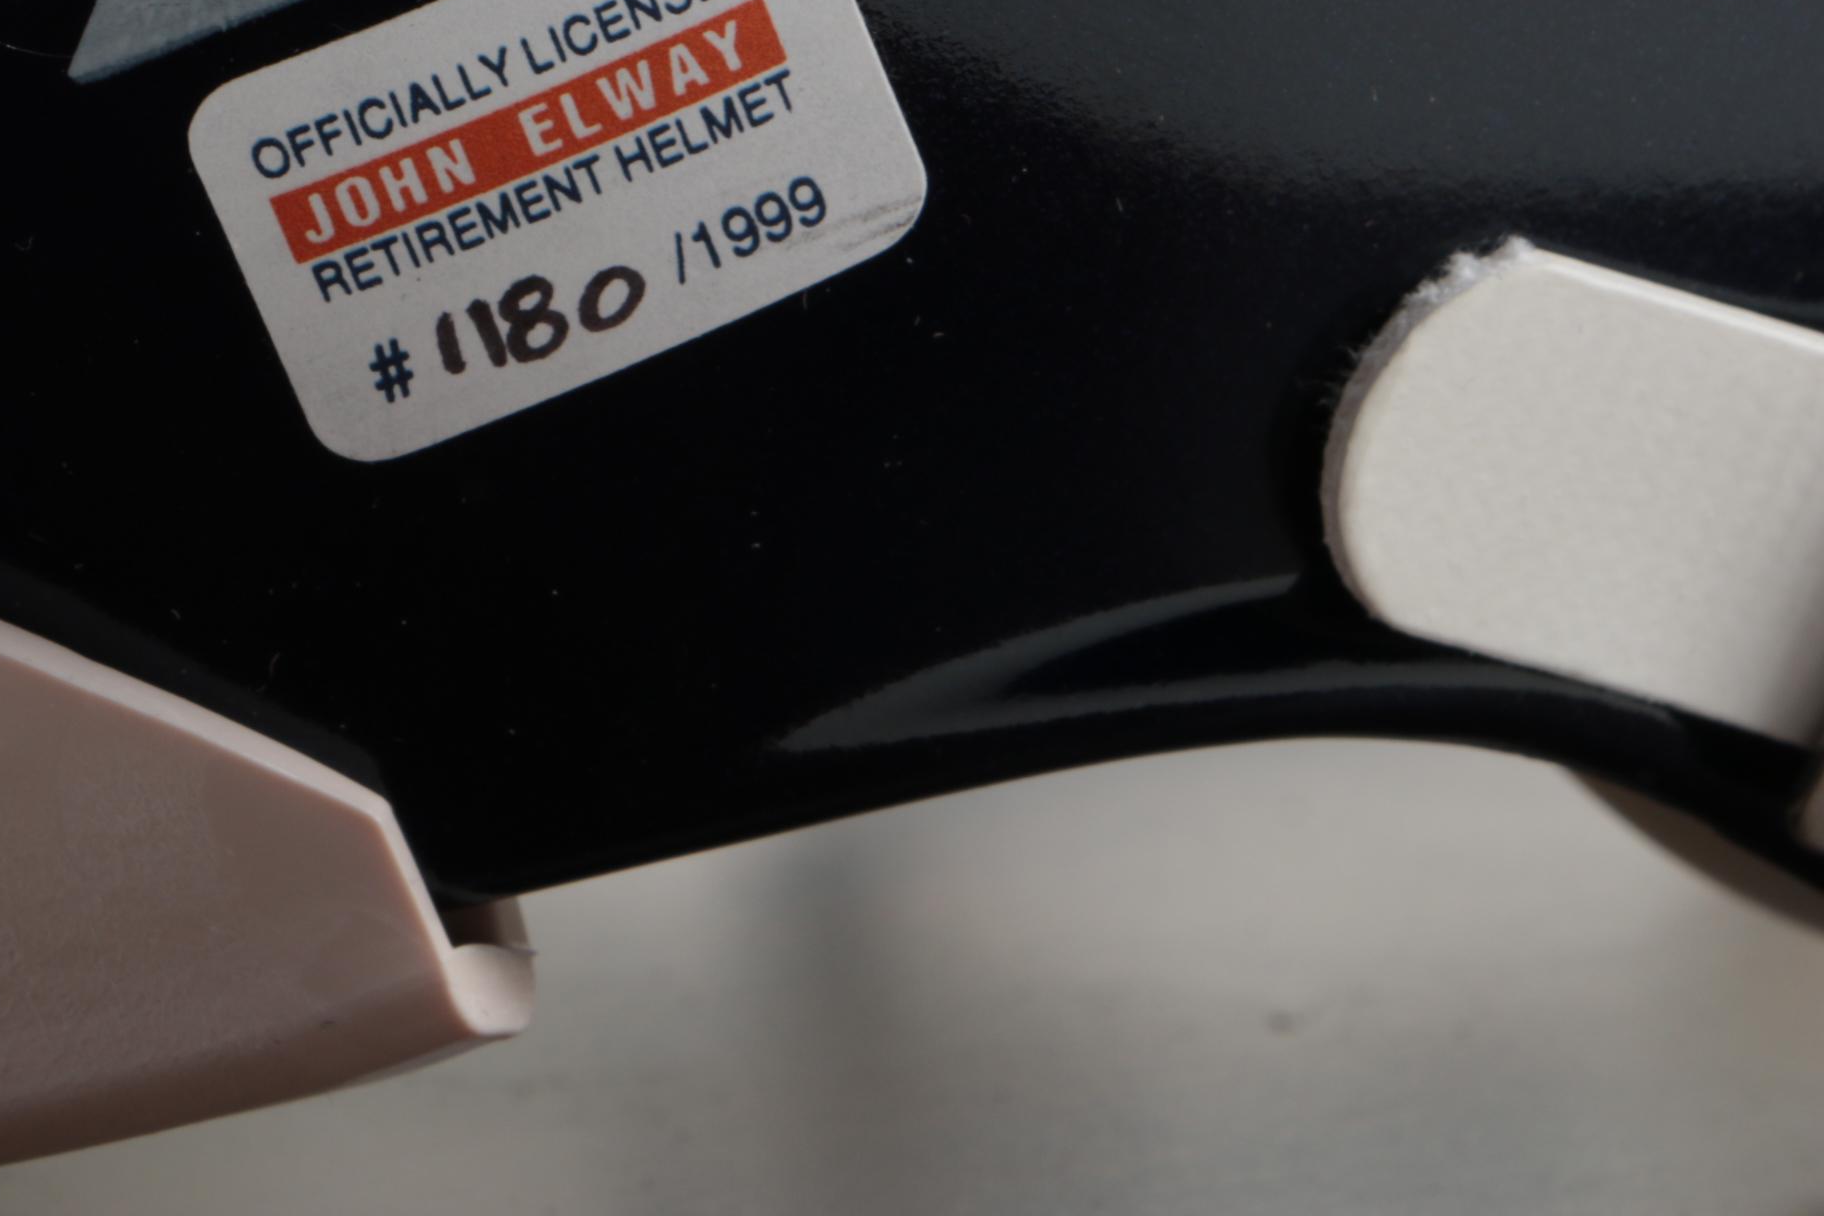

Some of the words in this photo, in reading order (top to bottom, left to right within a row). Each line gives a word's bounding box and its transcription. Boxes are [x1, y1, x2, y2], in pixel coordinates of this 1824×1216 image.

[250, 44, 513, 180] OFFICIALLY
[303, 139, 476, 246] JOHN
[517, 19, 744, 159] ELWAY
[310, 155, 606, 302] RETIREMENT
[614, 70, 795, 183] HELMET
